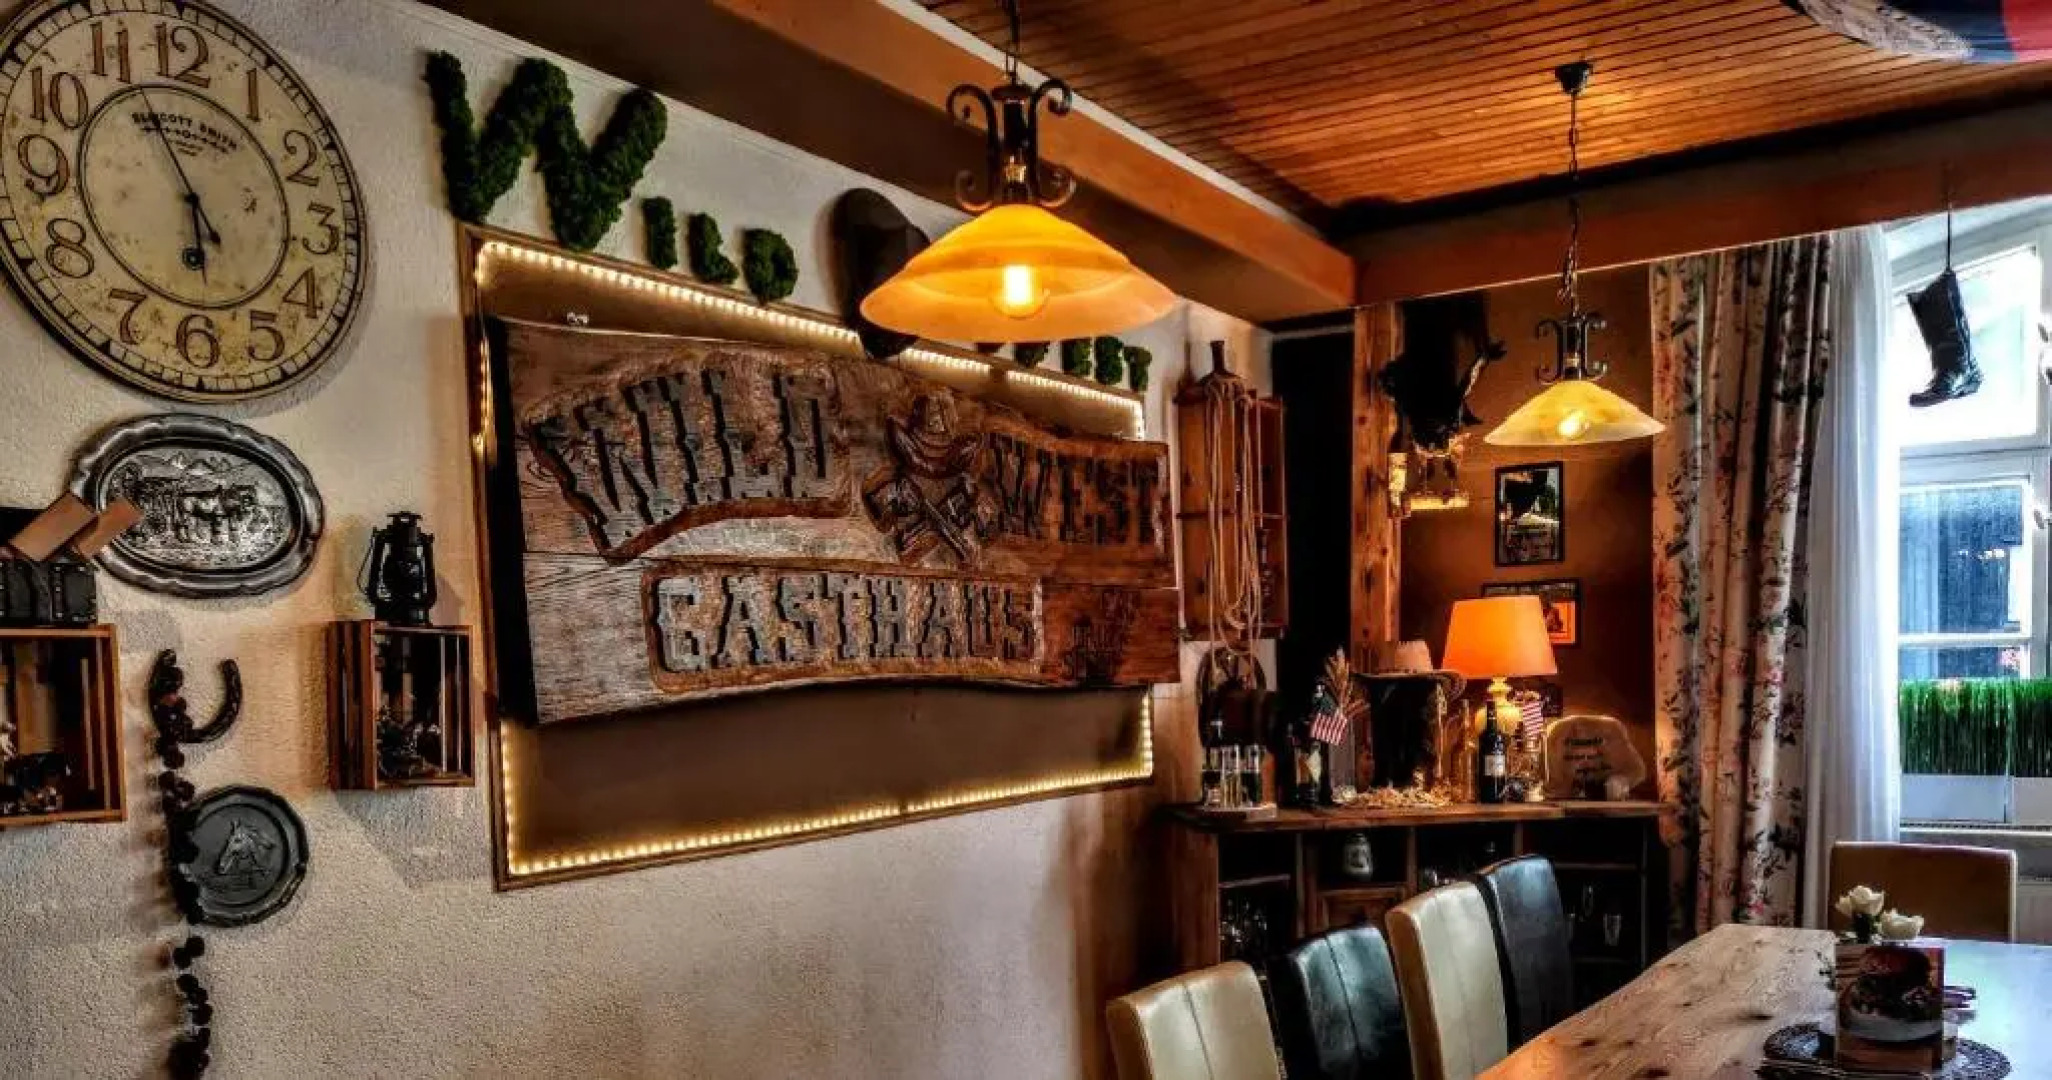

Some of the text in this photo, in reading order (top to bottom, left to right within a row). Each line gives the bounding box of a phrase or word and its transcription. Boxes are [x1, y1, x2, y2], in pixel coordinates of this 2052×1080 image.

[91, 20, 131, 83] 11
[155, 22, 211, 88] 12
[31, 65, 89, 130] 10
[245, 67, 261, 122] 1
[17, 133, 71, 196] 9
[282, 129, 320, 187] 2
[424, 50, 798, 304] WILD
[45, 217, 95, 279] 8
[301, 201, 340, 255] 3
[107, 288, 148, 346] 7
[281, 266, 324, 320] 4
[175, 313, 220, 369] 6
[247, 309, 286, 362] 5
[525, 364, 1162, 550] WILD WEST
[652, 572, 1037, 672] GASTHAUS
